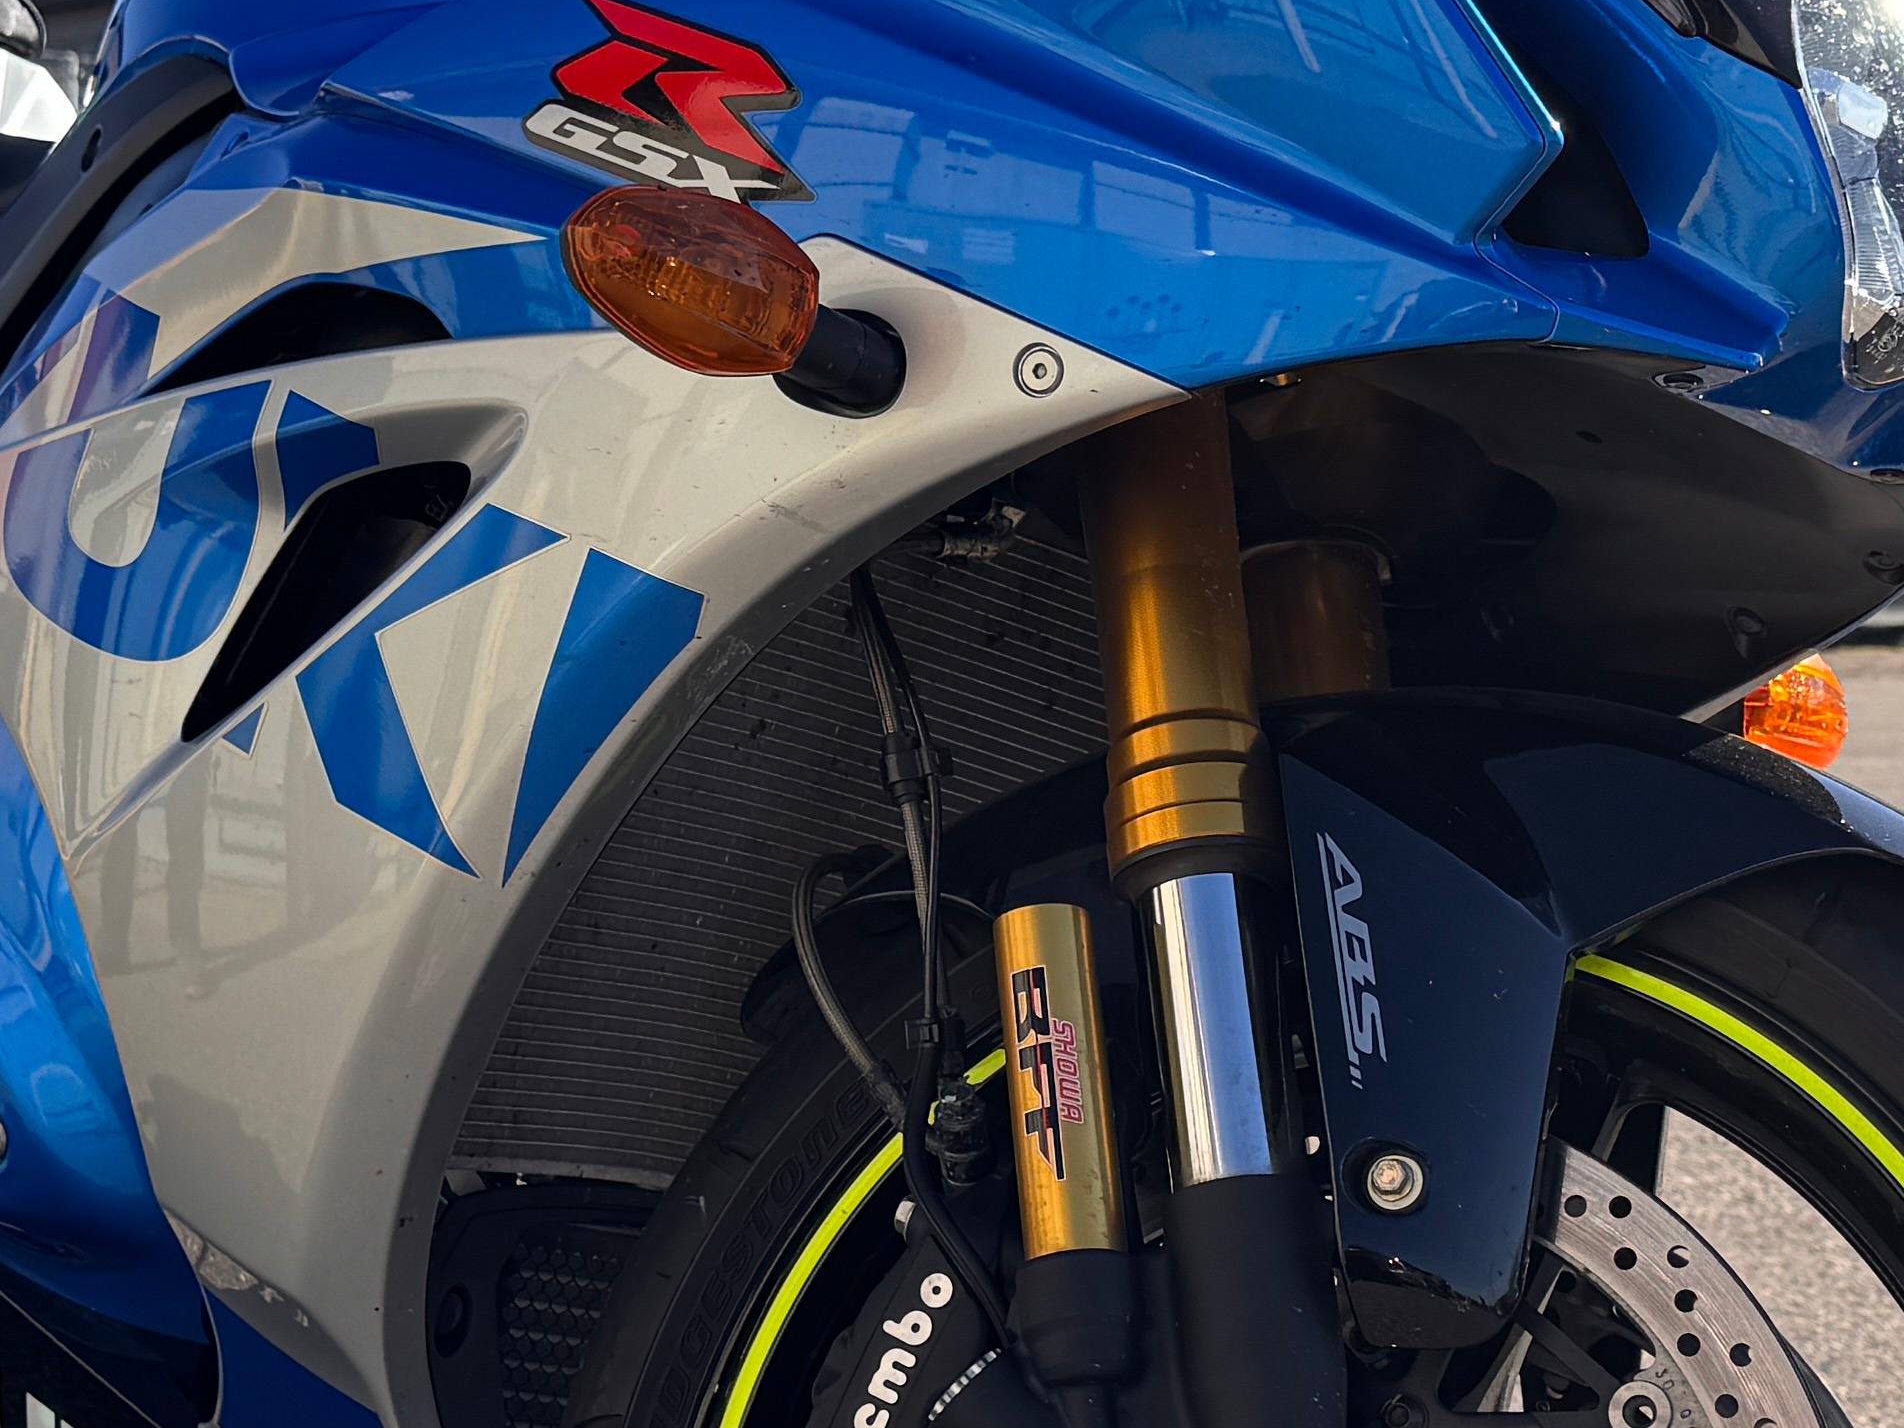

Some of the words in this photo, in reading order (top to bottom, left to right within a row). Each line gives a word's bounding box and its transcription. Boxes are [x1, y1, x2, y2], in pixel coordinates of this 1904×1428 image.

[525, 103, 781, 203] GSX
[1324, 832, 1388, 1063] ABS
[1050, 1018, 1084, 1125] SHOWA
